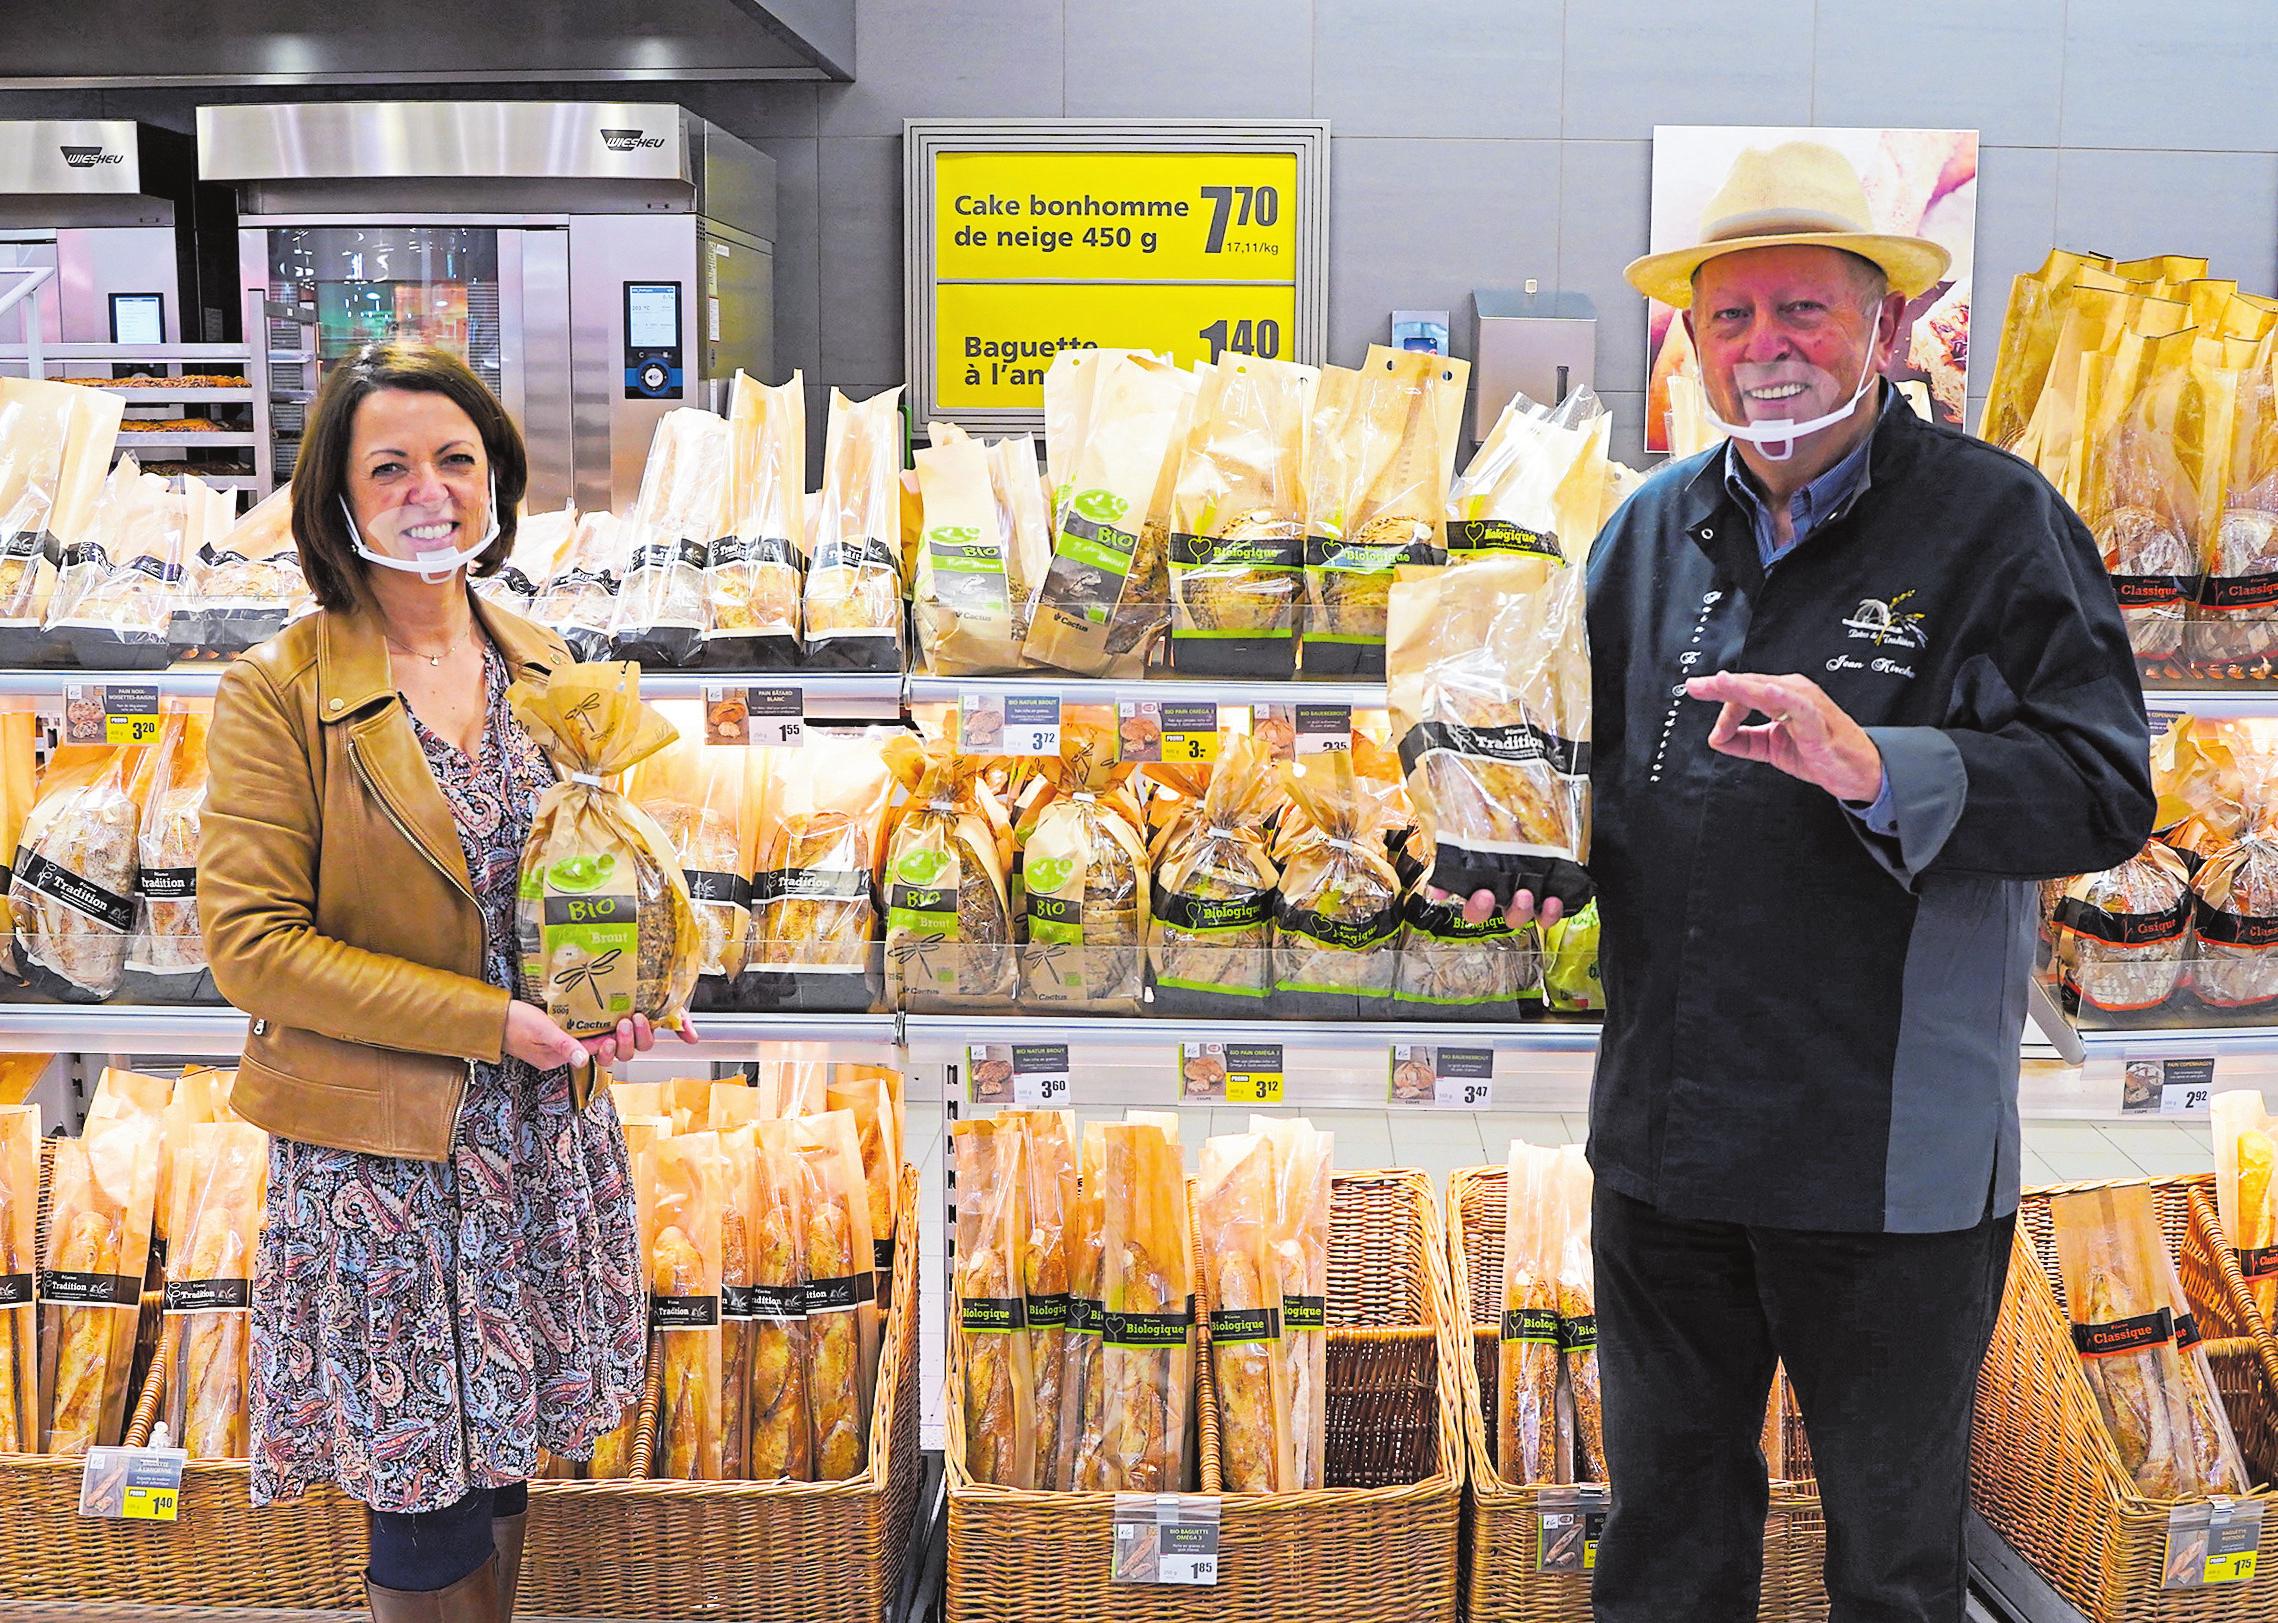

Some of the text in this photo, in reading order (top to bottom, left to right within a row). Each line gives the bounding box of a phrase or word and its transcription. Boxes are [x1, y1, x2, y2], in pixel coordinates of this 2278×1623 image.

[607, 138, 665, 148] WIESHEU
[66, 154, 124, 164] WIESHEU
[954, 194, 1189, 216] Cake bonhomme
[954, 226, 1158, 253] de neige 450 g
[1226, 242, 1279, 255] 17,11/kg
[964, 364, 980, 385] à
[1346, 550, 1410, 565] Biologique
[2121, 585, 2177, 598] Classique
[1061, 617, 1089, 632] Cactus
[1476, 733, 1545, 750] Tradition
[52, 876, 108, 911] Tradition
[576, 1020, 611, 1029] Cactus
[53, 1281, 87, 1291] Tradition
[1126, 1323, 1185, 1336] Biologique
[2094, 1326, 2152, 1345] Classique
